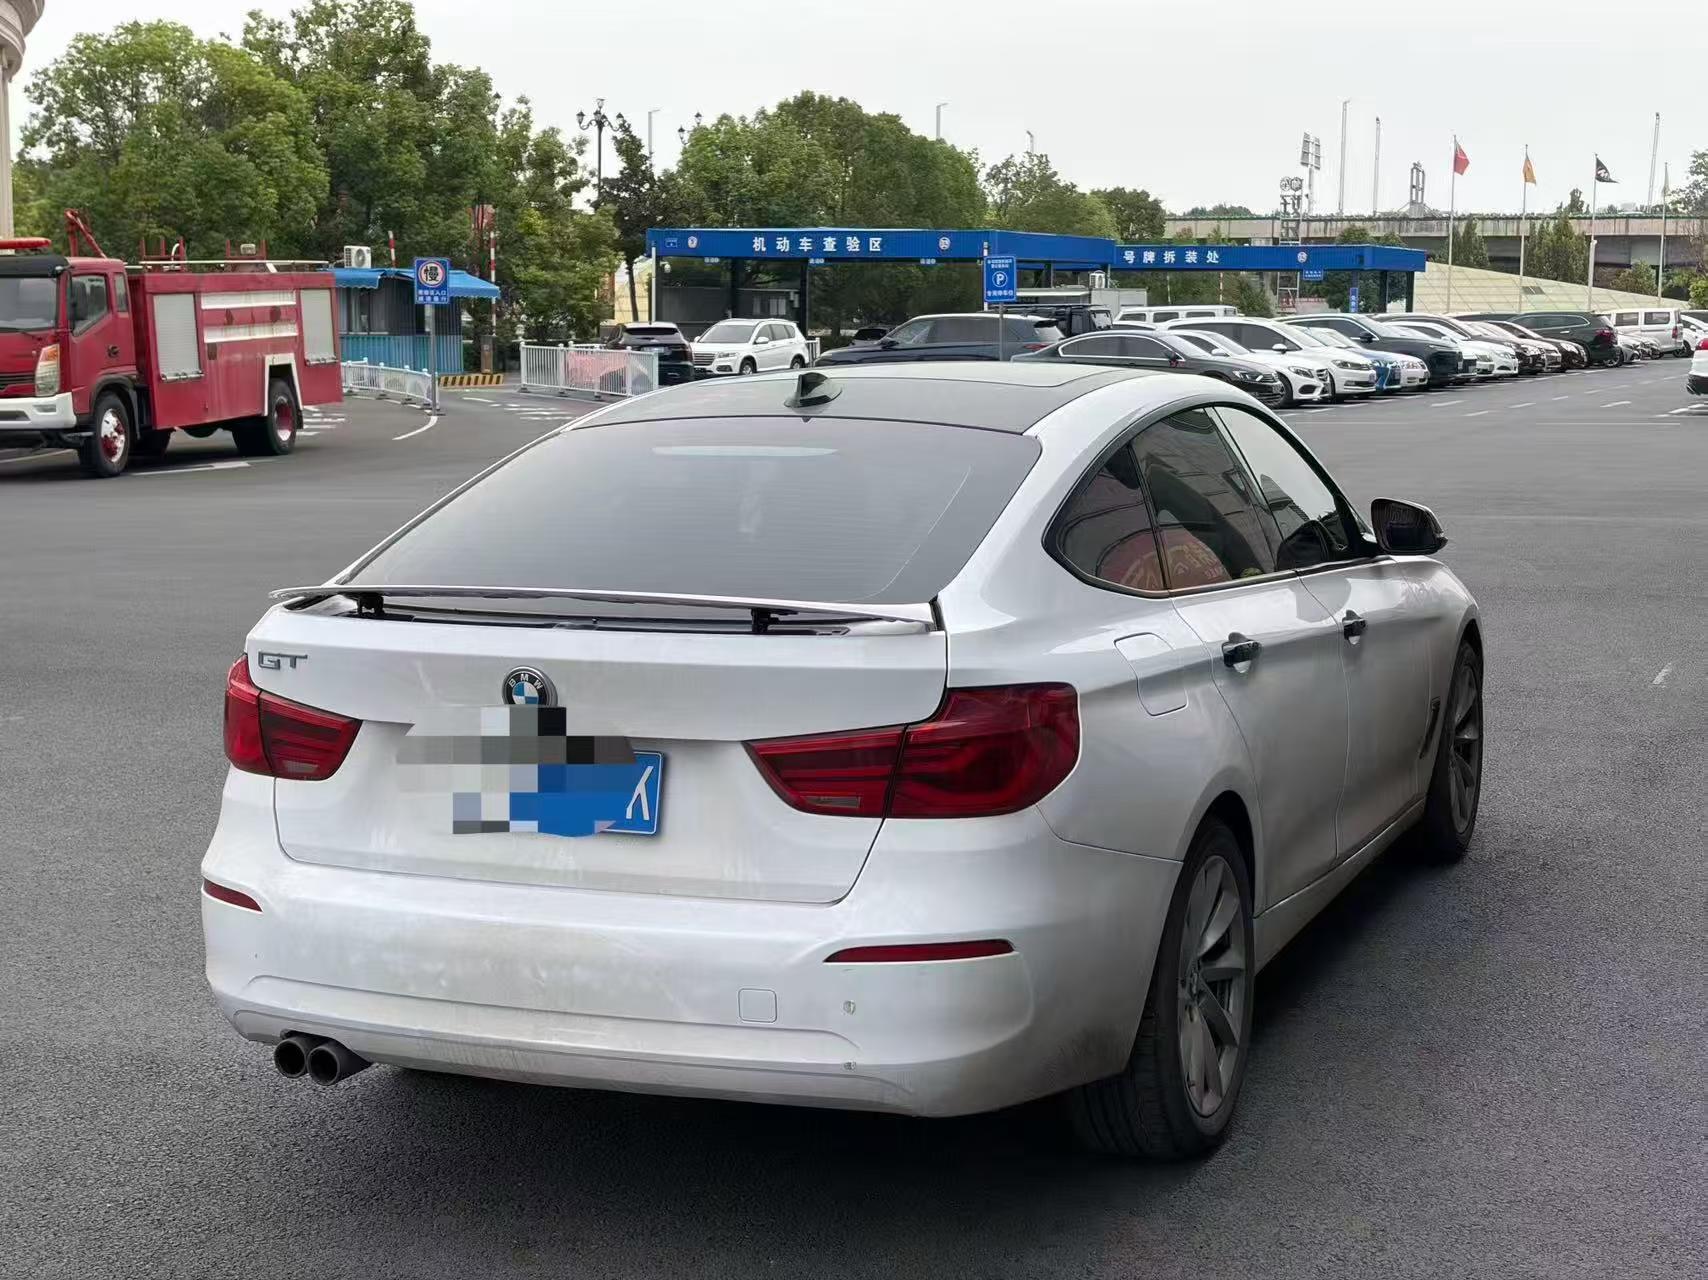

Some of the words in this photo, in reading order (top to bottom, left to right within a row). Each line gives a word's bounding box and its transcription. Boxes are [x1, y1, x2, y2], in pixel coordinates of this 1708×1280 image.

[752, 236, 882, 252] 机动车查验区
[1123, 250, 1219, 264] 号牌拆装处
[423, 265, 440, 282] 慢
[996, 273, 1005, 285] P
[258, 651, 308, 670] GT
[508, 673, 543, 690] BMW
